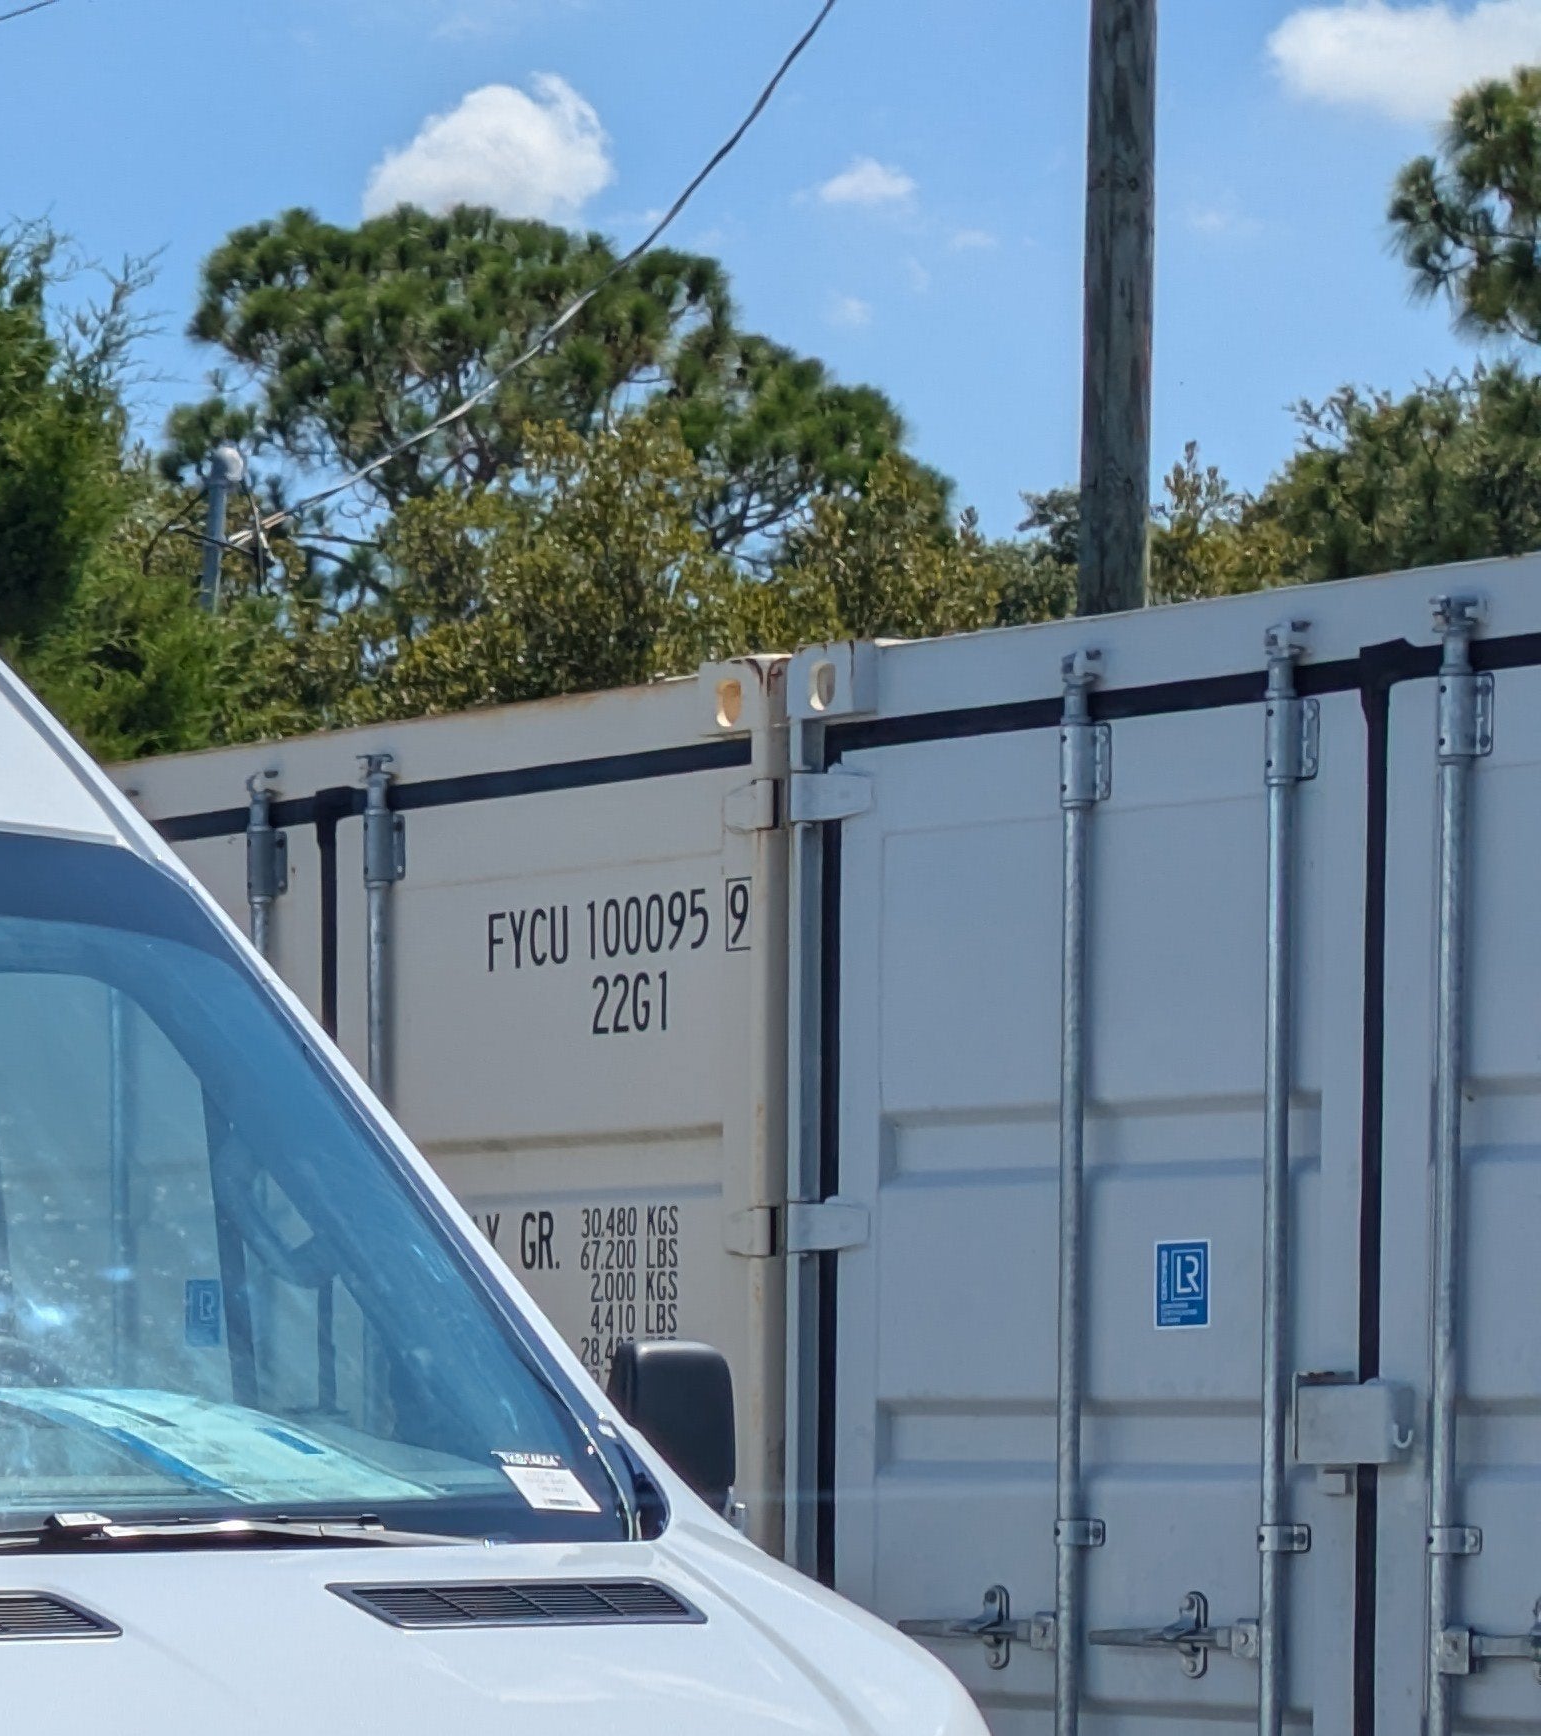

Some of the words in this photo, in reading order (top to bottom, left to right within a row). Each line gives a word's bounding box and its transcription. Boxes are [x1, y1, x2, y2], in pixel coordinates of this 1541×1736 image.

[487, 904, 569, 973] FYCU
[586, 888, 709, 961] 100095
[729, 883, 750, 944] 9
[592, 970, 668, 1035] 22G1
[581, 1207, 638, 1239] 30.480
[647, 1205, 679, 1237] KGS
[520, 1211, 561, 1270] GR.
[580, 1239, 637, 1271] 67.200
[646, 1238, 679, 1269] LBS
[645, 1270, 679, 1302] KGS
[645, 1303, 678, 1335] LBS
[580, 1337, 634, 1367] 28.4
